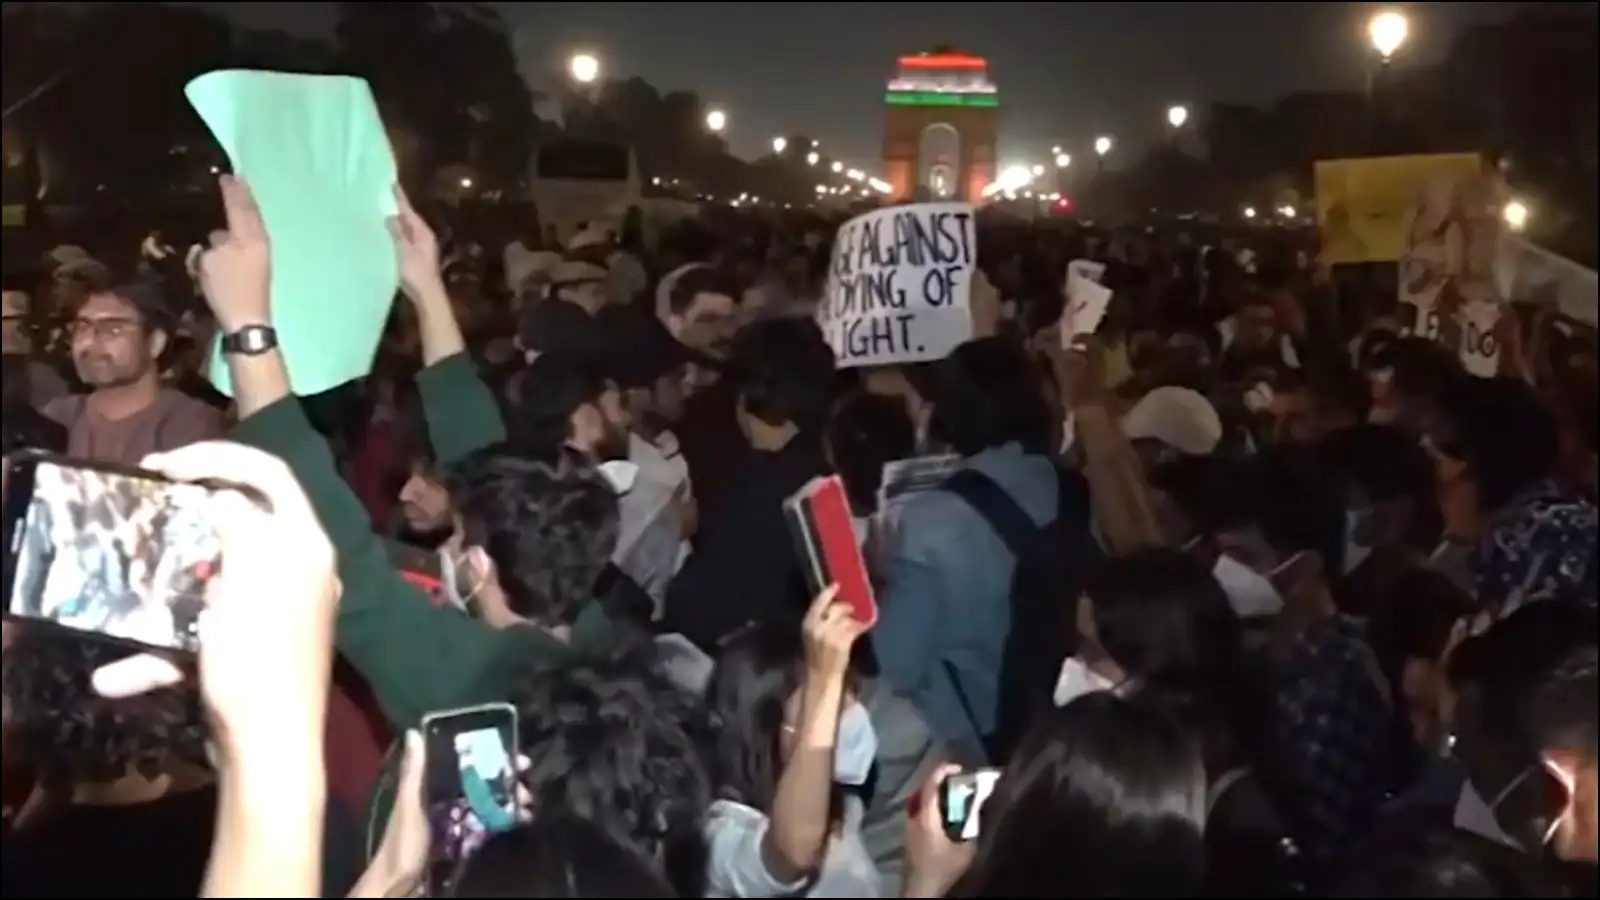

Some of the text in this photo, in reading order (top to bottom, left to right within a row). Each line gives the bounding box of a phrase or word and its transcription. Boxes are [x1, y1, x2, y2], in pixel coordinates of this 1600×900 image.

[833, 212, 970, 276] GE AGAINST
[835, 269, 906, 319] DYING
[922, 265, 963, 307] OF
